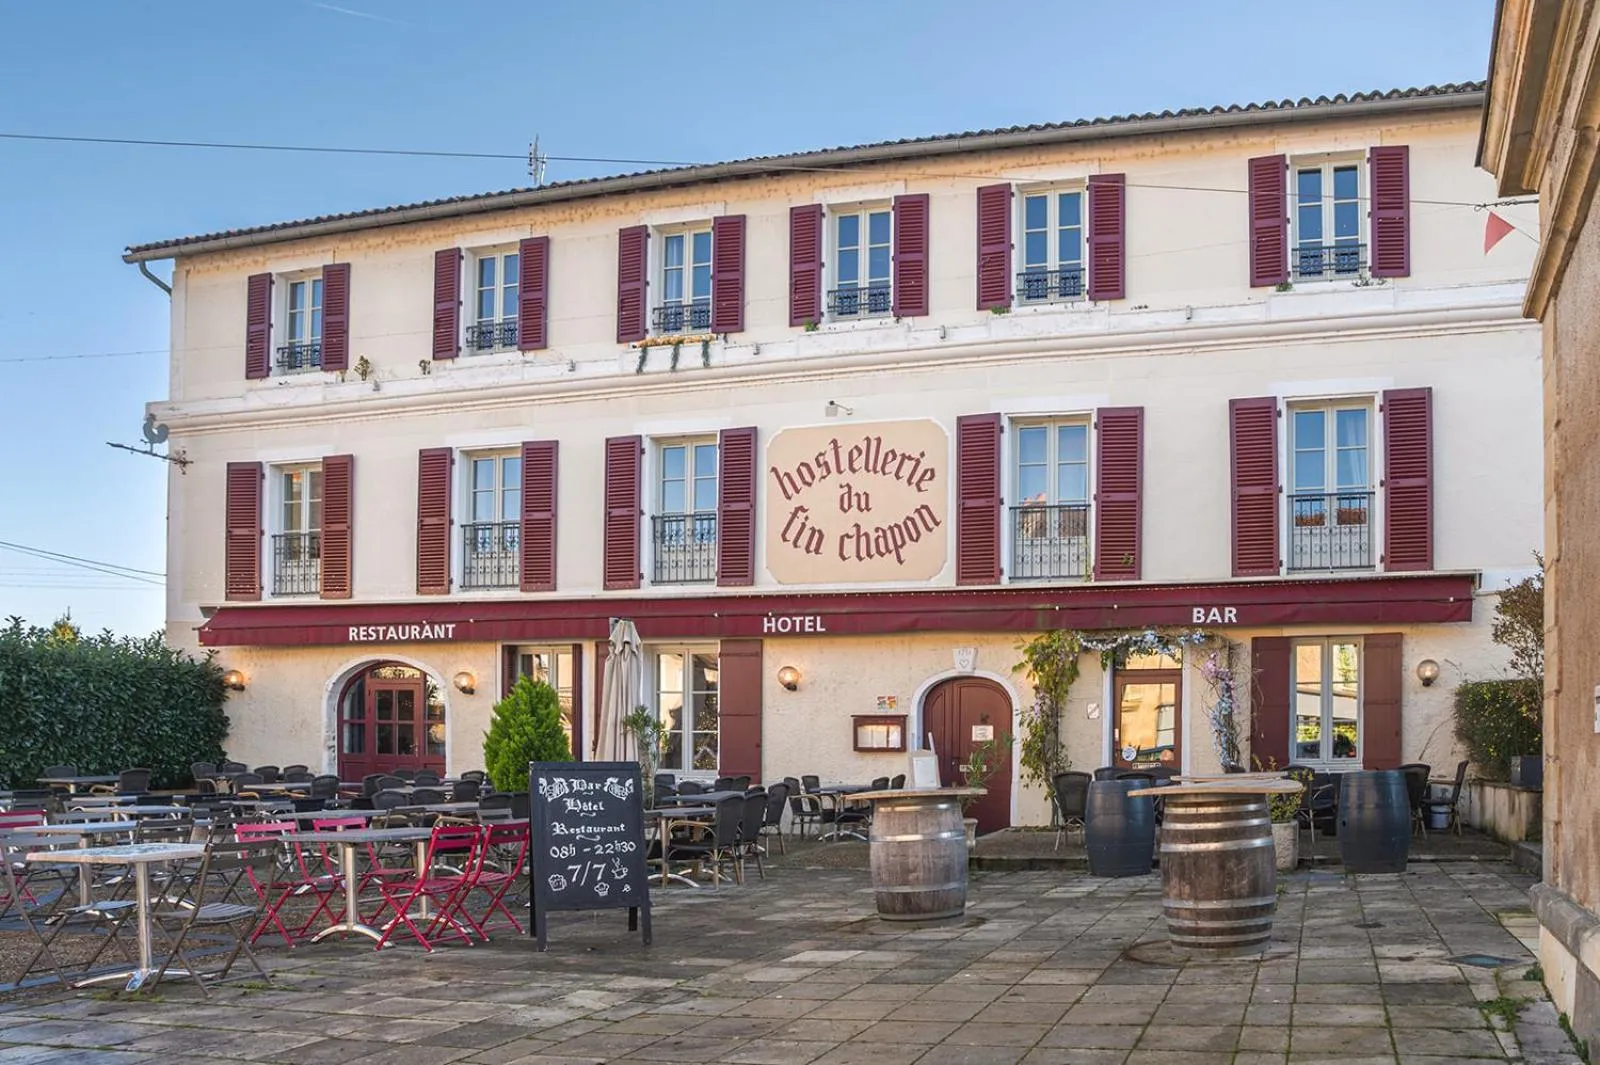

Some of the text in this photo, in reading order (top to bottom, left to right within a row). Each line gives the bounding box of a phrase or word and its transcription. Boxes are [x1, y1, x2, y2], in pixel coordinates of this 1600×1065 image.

[770, 436, 936, 500] hostellerie
[839, 483, 872, 514] du
[781, 504, 942, 565] fin chapon
[1192, 606, 1238, 623] BAR
[348, 624, 456, 641] RESTAURANT
[763, 616, 826, 633] HOTEL
[569, 778, 602, 793] Bar
[551, 822, 626, 836] Restaurant
[567, 860, 606, 886] 7/7
